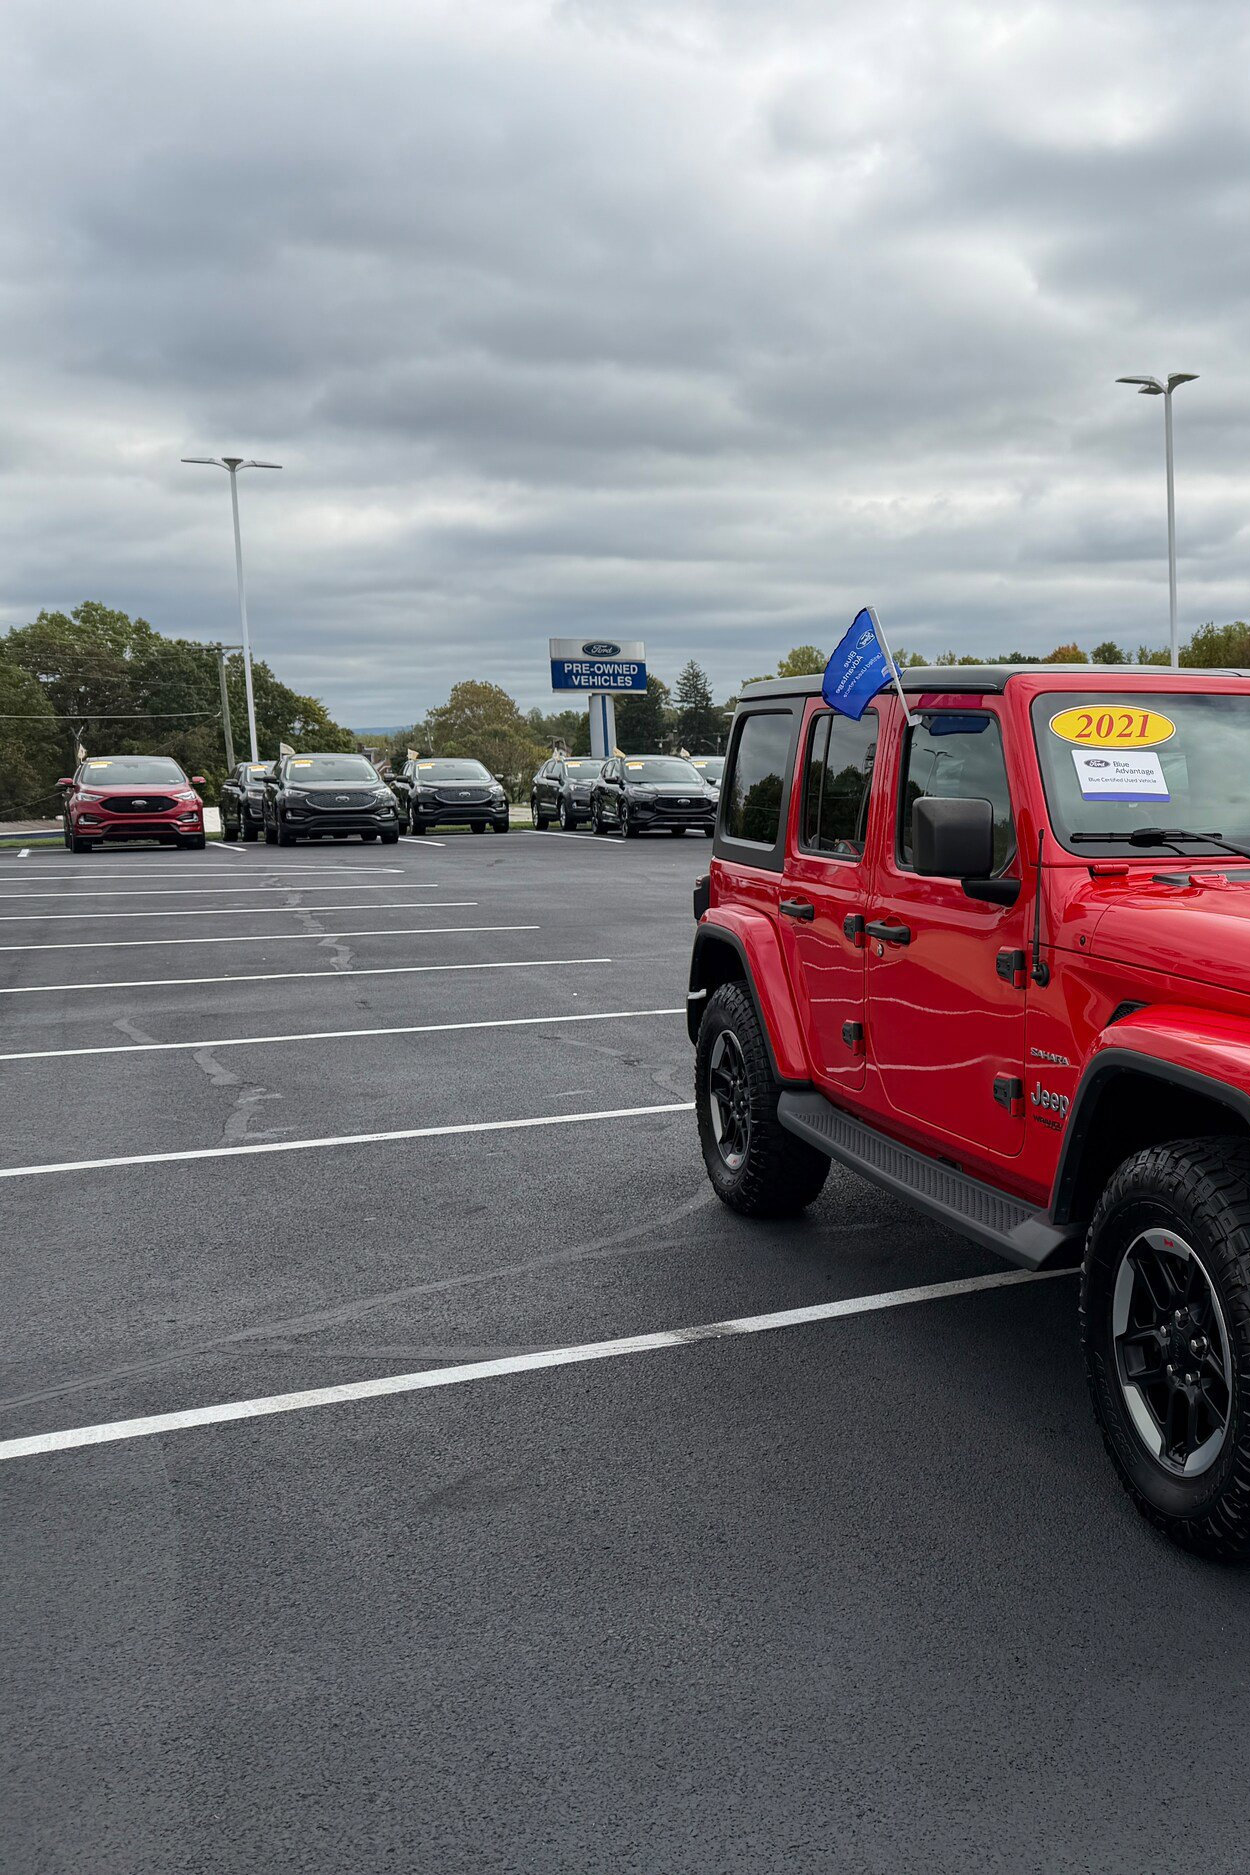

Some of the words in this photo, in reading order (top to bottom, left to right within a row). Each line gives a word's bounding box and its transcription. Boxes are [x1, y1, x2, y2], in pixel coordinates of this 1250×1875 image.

[591, 645, 613, 654] Ford
[564, 663, 638, 675] PRE-OWNED
[572, 675, 632, 686] VEHICLES
[1075, 713, 1149, 738] 2021
[1115, 768, 1155, 776] Advantage
[1030, 1047, 1070, 1066] SAHARA
[1030, 1081, 1070, 1118] Jeep
